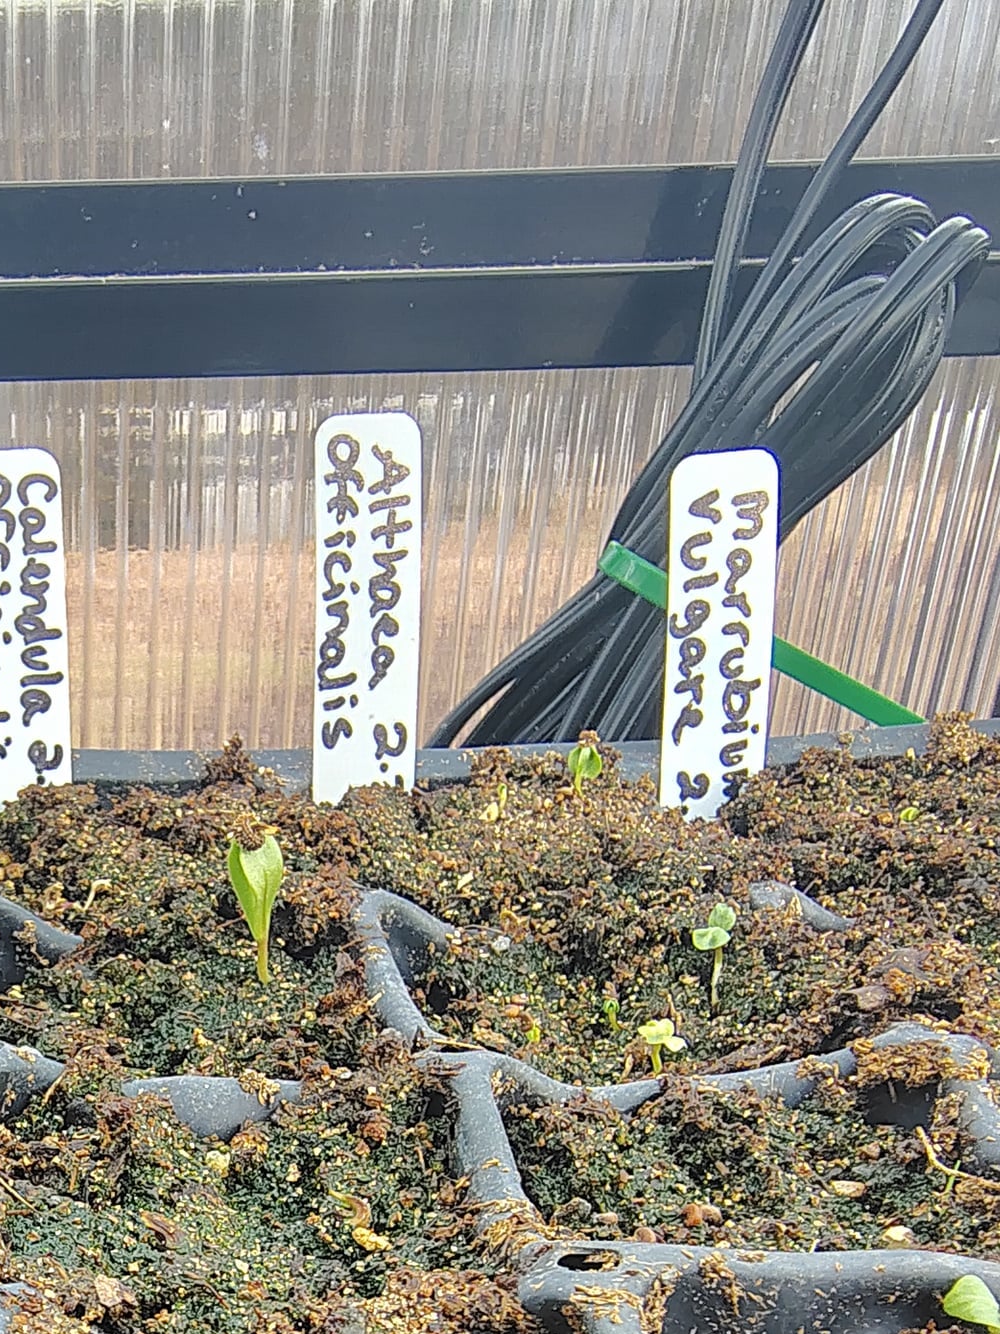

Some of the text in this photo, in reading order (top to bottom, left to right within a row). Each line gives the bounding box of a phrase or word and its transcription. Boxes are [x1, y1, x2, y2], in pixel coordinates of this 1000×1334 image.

[15, 473, 64, 727] Calendula
[368, 444, 412, 788] Althaea 2.
